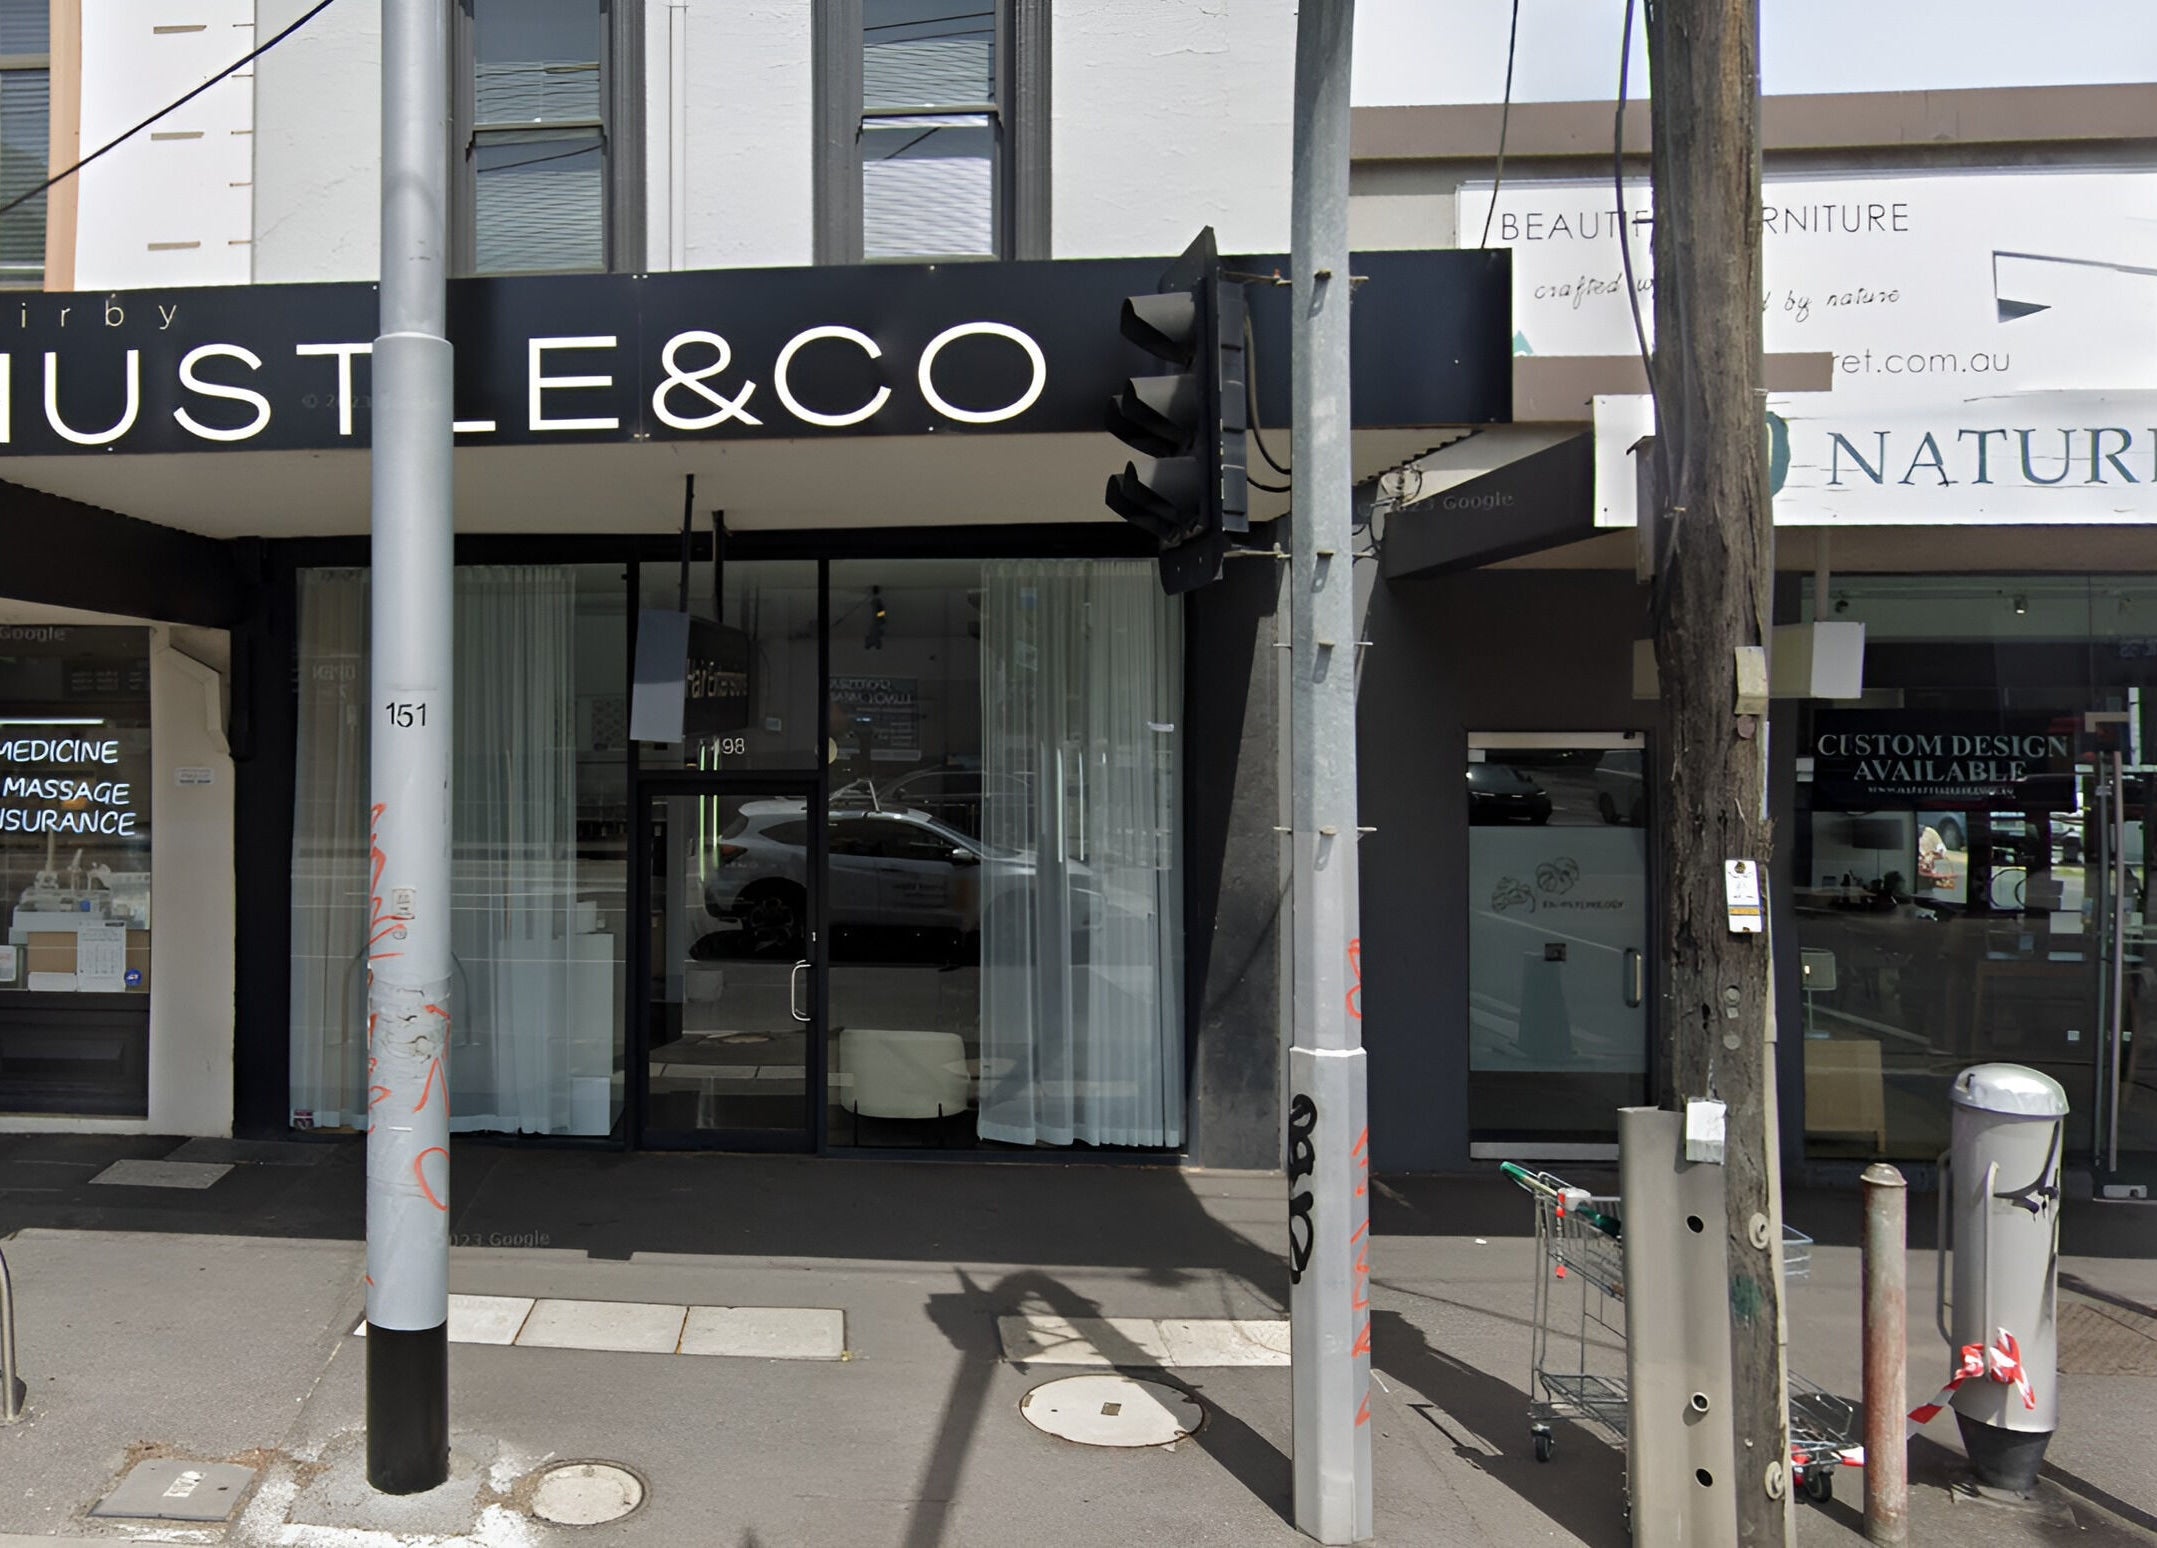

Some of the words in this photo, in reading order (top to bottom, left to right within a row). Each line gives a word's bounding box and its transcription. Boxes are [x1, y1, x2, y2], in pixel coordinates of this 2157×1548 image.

[1502, 210, 1649, 241] BEAUTF
[1534, 272, 1623, 310] crafted
[1784, 290, 1812, 323] by
[0, 321, 1047, 444] USTE&CO
[1826, 427, 2157, 487] NATUR
[385, 702, 428, 728] 151
[1817, 733, 1943, 757] CUSTOM
[1951, 734, 2069, 758] DESIGN
[1853, 759, 2029, 783] AVAILABLE
[2, 776, 131, 805] MASSAGE
